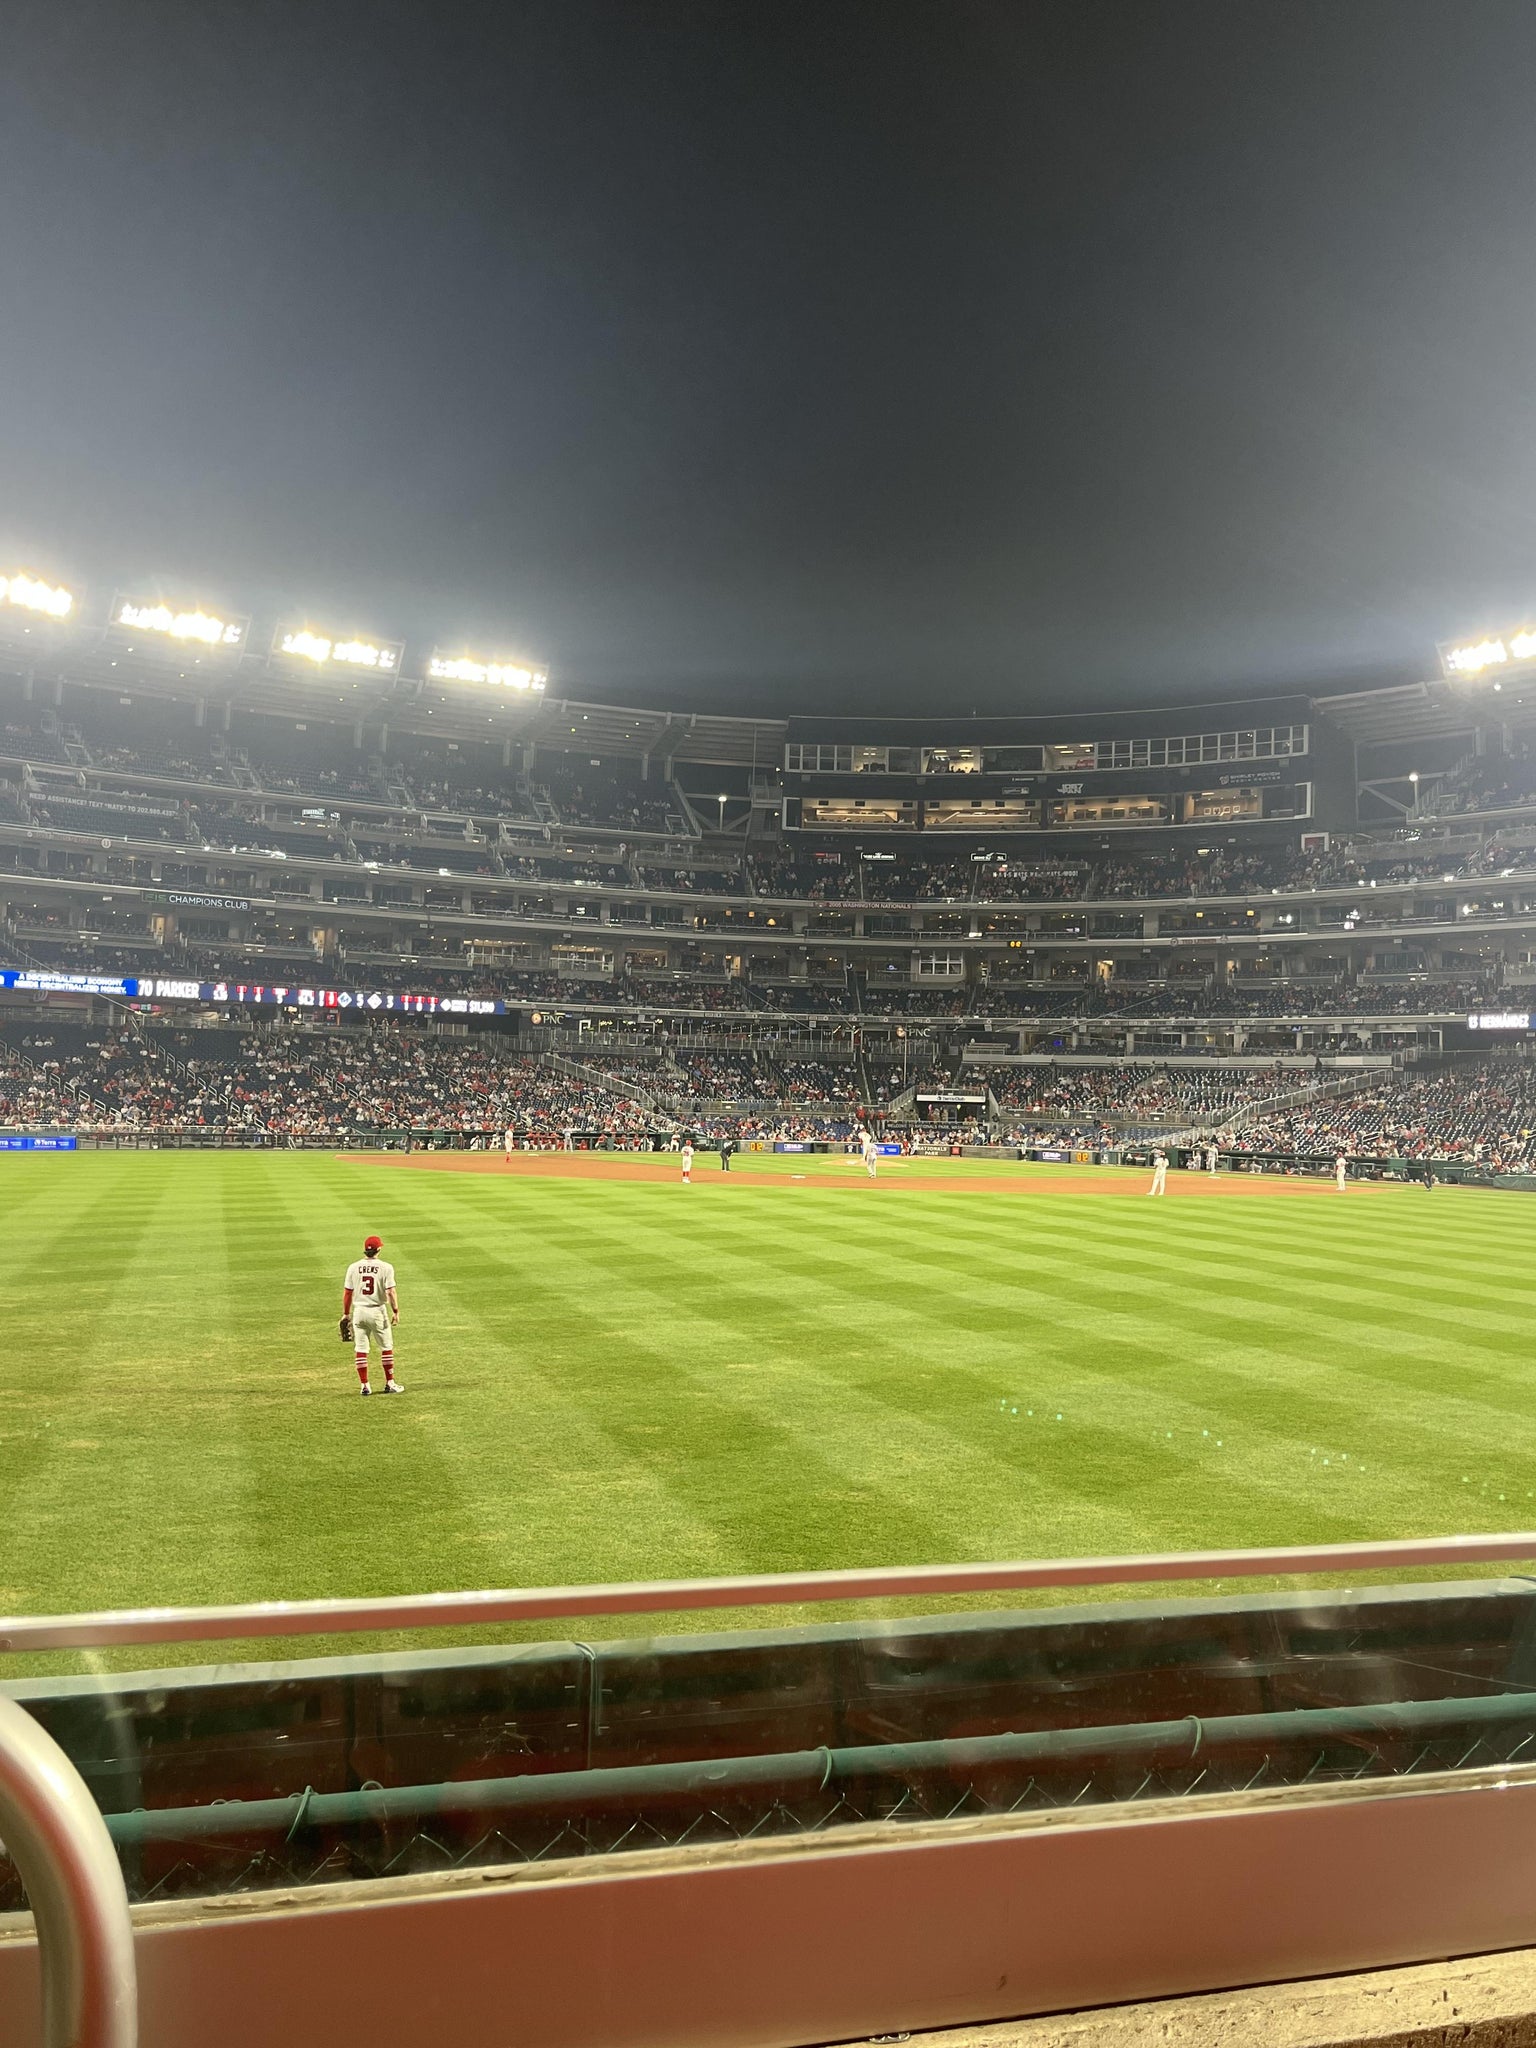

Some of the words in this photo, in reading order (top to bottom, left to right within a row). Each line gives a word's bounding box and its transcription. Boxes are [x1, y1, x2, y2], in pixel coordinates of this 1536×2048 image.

[168, 894, 224, 908] CHAMPIONS
[224, 899, 249, 910] CLUB
[138, 979, 153, 997] 70
[156, 980, 200, 999] PARKER
[543, 1014, 564, 1025] PNC
[908, 1028, 931, 1038] PNC
[41, 1139, 57, 1147] Terra
[358, 1266, 379, 1274] CREWS
[362, 1275, 374, 1296] 3
